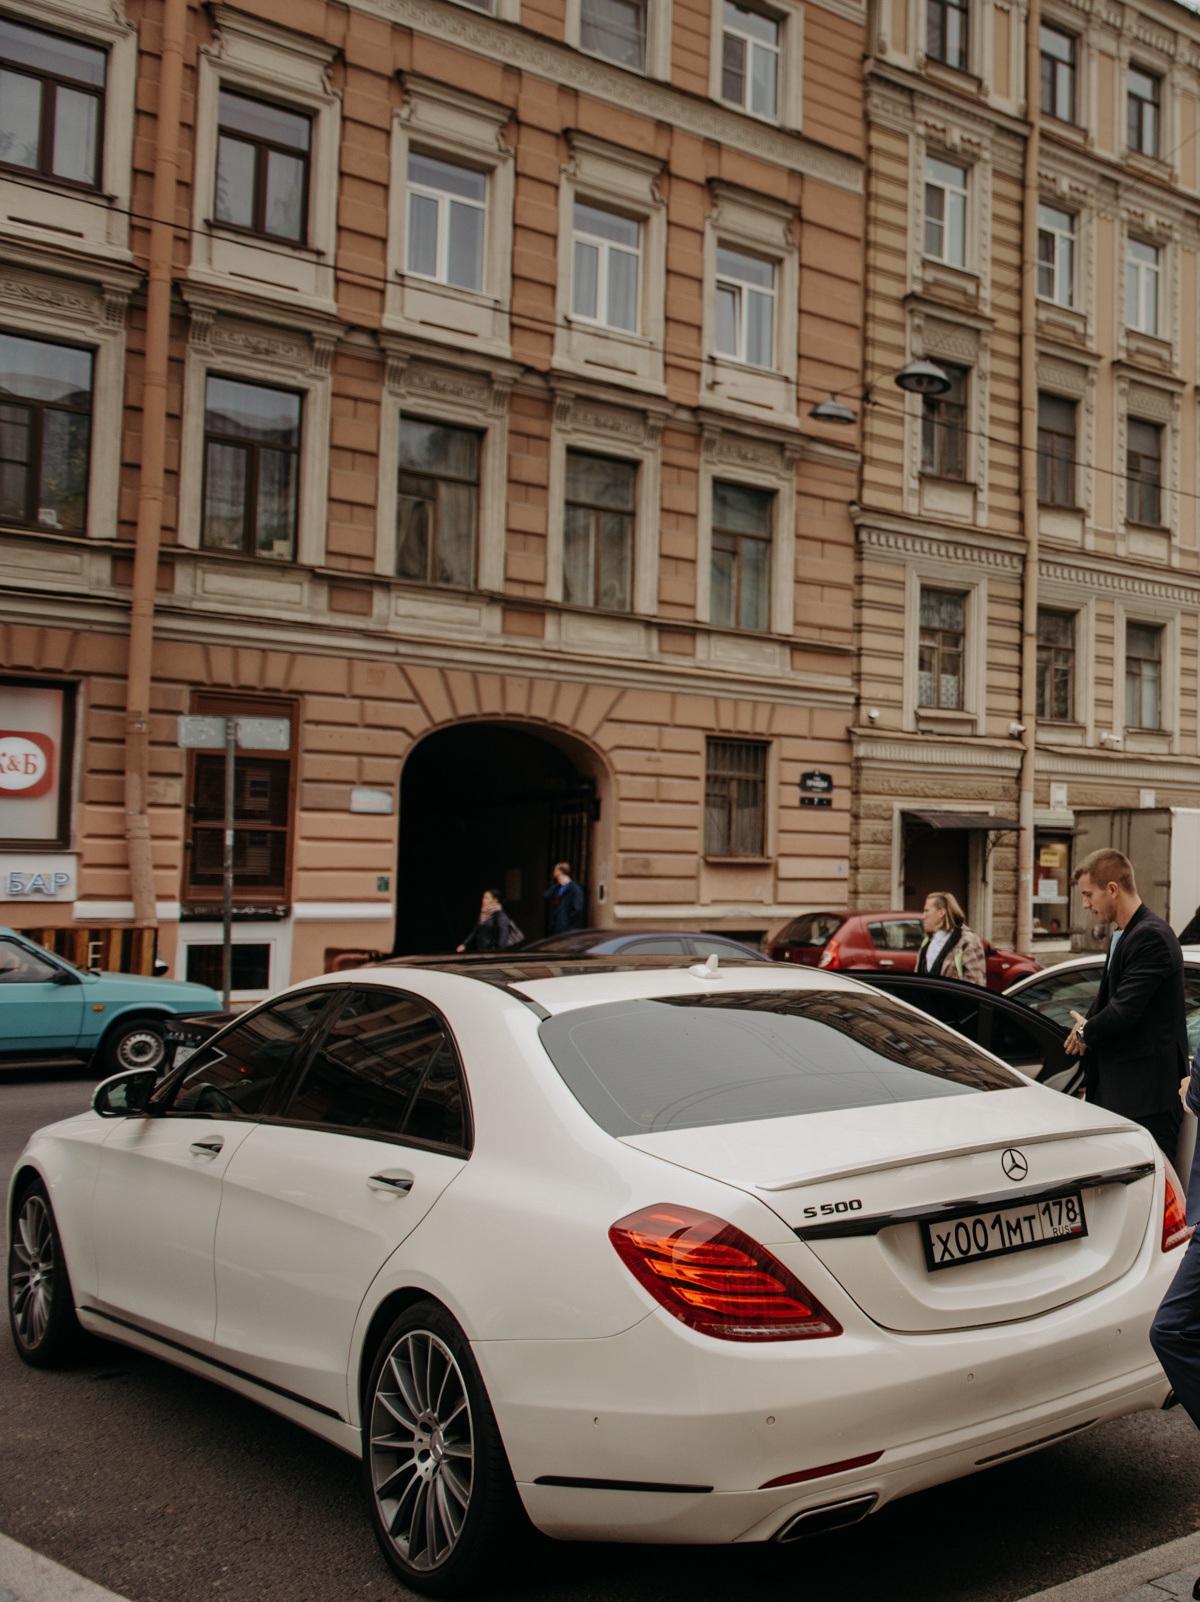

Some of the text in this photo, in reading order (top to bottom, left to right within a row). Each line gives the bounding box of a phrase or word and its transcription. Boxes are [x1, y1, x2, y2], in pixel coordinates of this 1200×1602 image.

[7, 872, 69, 895] БАР
[803, 1199, 863, 1219] S 500
[935, 1198, 1078, 1262] Х001МТ 178
[1053, 1224, 1071, 1237] RUS
